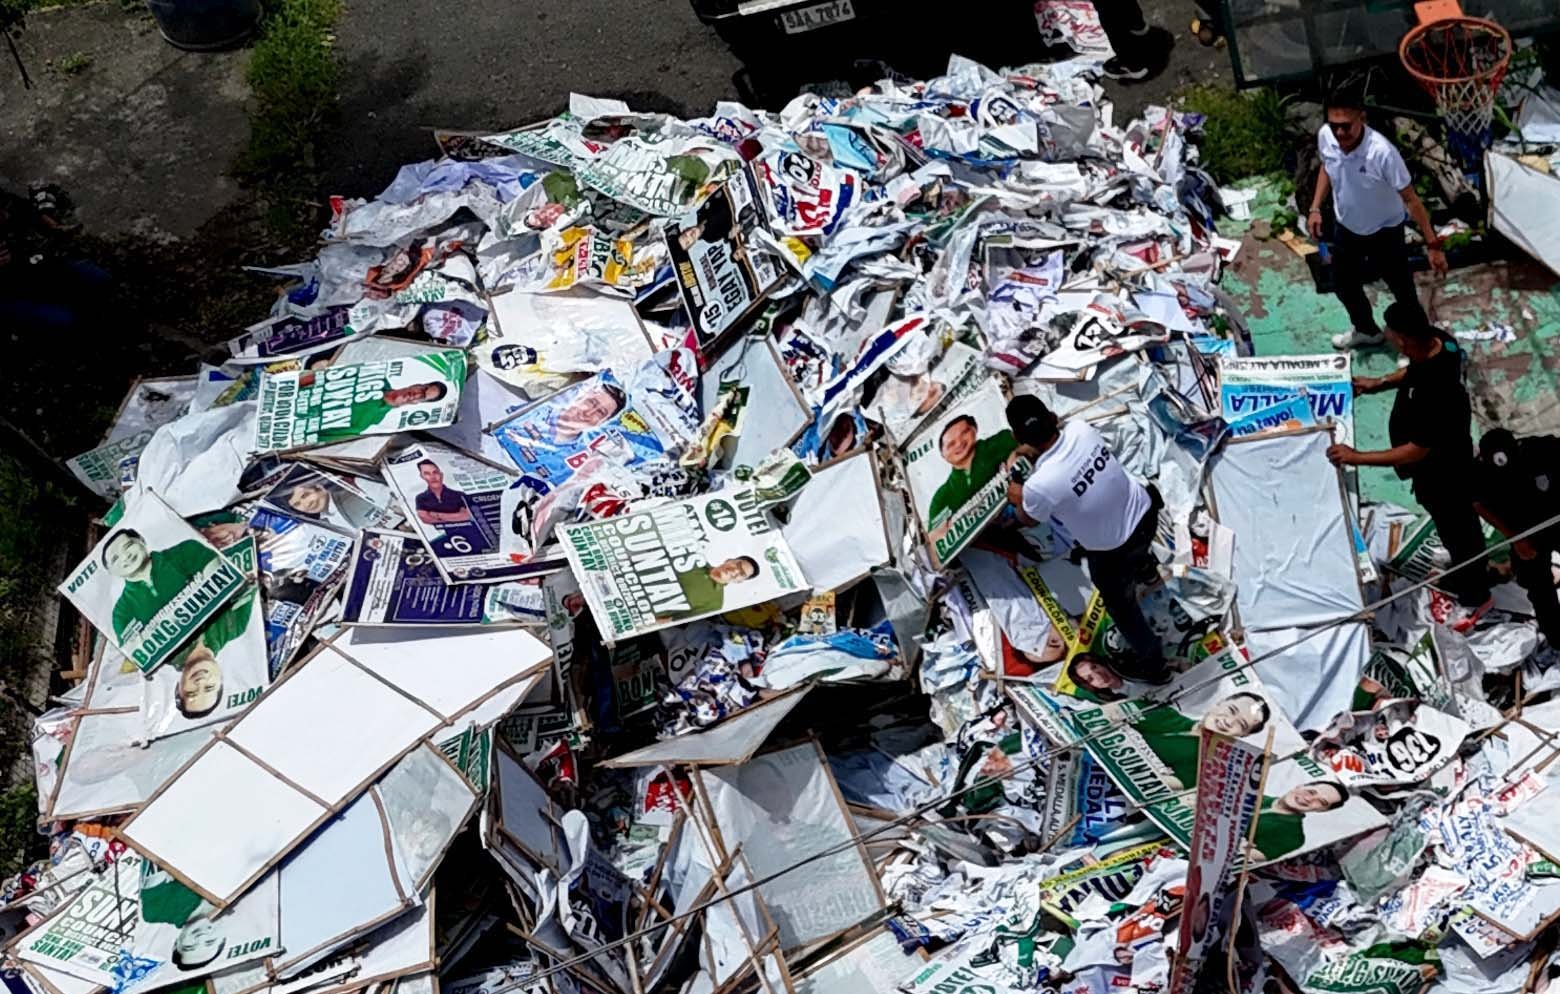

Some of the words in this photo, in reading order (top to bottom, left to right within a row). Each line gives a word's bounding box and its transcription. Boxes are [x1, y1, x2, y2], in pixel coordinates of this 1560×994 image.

[1073, 445, 1114, 499] DPOS
[733, 488, 769, 535] VOTE!
[566, 529, 598, 573] SUNTAY
[601, 524, 656, 626] COUNCILOR
[616, 515, 691, 616] SUNTAY
[66, 560, 100, 595] VOTE!
[132, 612, 181, 668] BONG
[176, 565, 240, 627] SUNTAY
[1110, 740, 1175, 804] SUNTAY
[29, 941, 78, 966] SUNTAY
[227, 935, 271, 960] VOTE!
